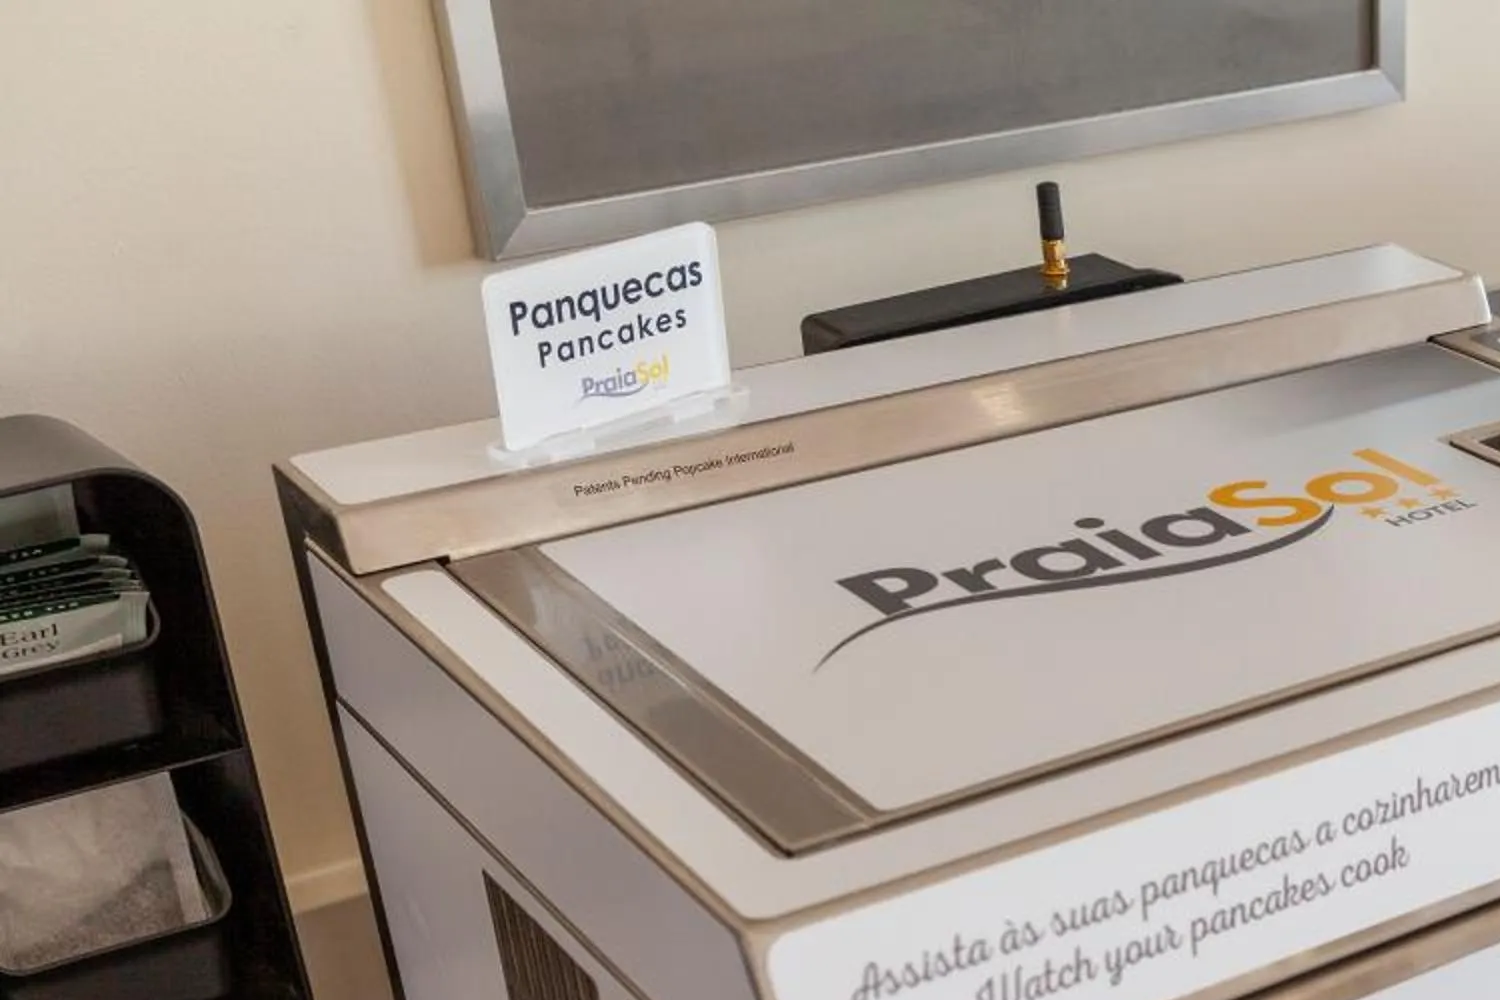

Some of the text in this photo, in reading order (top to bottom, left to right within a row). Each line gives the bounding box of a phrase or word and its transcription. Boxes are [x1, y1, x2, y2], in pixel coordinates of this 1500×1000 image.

[509, 260, 703, 335] Panquecas
[538, 307, 687, 367] Pancakes
[581, 354, 670, 396] PraiaSol
[574, 442, 795, 497] Patents Pending Popcake International
[837, 448, 1441, 617] PraiaSol
[1384, 498, 1479, 529] HOTEL
[0, 623, 58, 647] Earl
[999, 914, 1044, 956] às
[1051, 886, 1134, 938] suas
[1139, 830, 1310, 924] panquecas
[1315, 820, 1337, 848] a
[1103, 923, 1184, 986] your
[1190, 864, 1336, 956] pancakes
[1340, 836, 1410, 888] cook
